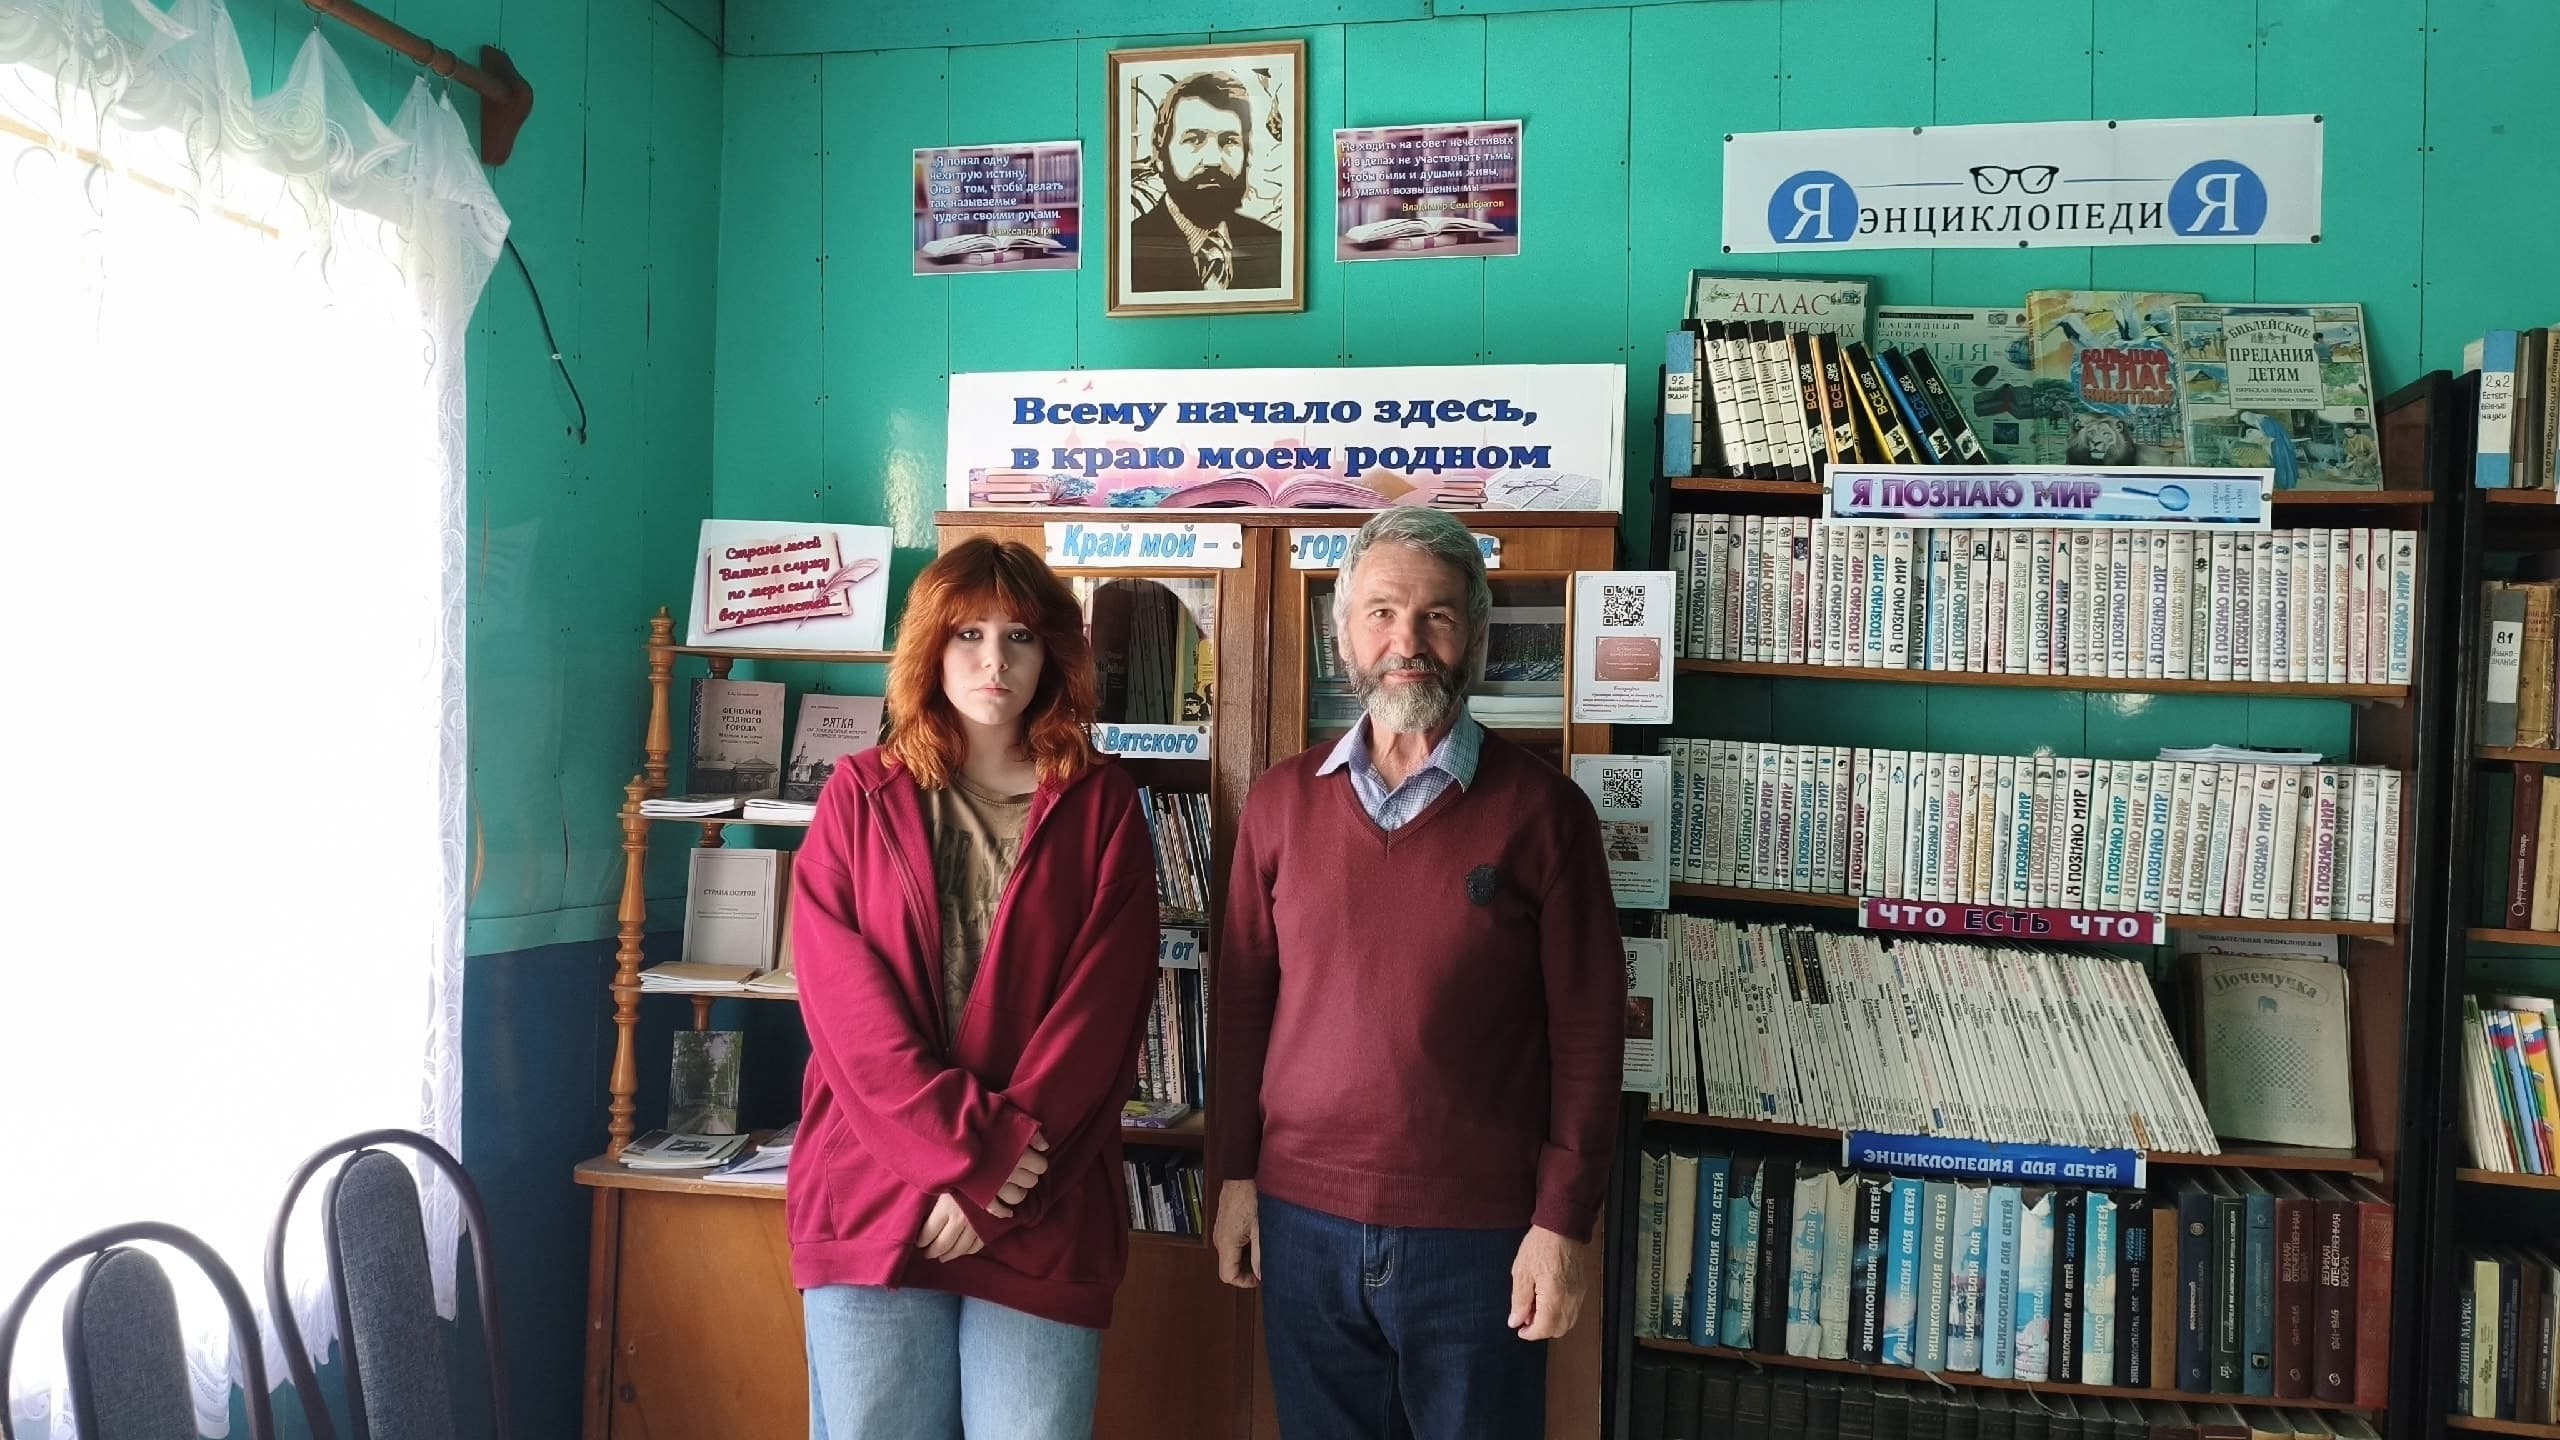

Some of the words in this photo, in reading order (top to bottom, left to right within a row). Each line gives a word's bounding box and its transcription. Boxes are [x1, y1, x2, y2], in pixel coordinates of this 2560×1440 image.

[1342, 142, 1354, 151] Не
[1358, 141, 1396, 151] ходить
[1416, 139, 1446, 148] совет
[1450, 137, 1514, 146] нечестивых
[947, 157, 979, 166] понял
[983, 156, 1009, 167] одну
[1342, 158, 1350, 166] И
[1364, 157, 1394, 168] делах
[1414, 155, 1480, 166] участвовать
[1484, 153, 1513, 161] тьмы,
[930, 184, 950, 194] Она
[964, 185, 988, 194] том,
[991, 182, 1023, 191] чтобы
[1026, 182, 1063, 192] делать
[931, 170, 982, 182] нехитрую
[1343, 171, 1375, 182] Чтобы
[1379, 171, 1406, 180] были
[1420, 170, 1462, 180] душами
[930, 200, 947, 208] так
[951, 198, 1016, 207] называемые
[1342, 188, 1351, 197] И
[1354, 188, 1389, 199] умами
[1393, 185, 1459, 195] возвышенны
[1464, 184, 1478, 192] мы
[933, 214, 969, 224] чудеса
[973, 212, 1015, 220] своими
[1019, 210, 1061, 222] руками.
[1402, 202, 1447, 212] Владимир
[1784, 183, 1835, 241] Я
[1859, 202, 2163, 238] ЭНЦИКЛОПЕДИ
[2187, 174, 2242, 234] Я
[1732, 291, 1832, 316] АТЛАС
[2228, 319, 2311, 338] БИБЛЕЙСКИЕ
[2230, 348, 2313, 364] ПРЕДАНИЯ
[2082, 363, 2172, 389] АТЛАС
[2248, 368, 2299, 382] ДЕТЯМ
[1804, 384, 1817, 410] ВСЕ
[1831, 383, 1844, 408] ВСЕ
[1870, 390, 1888, 415] ВСЕ
[1013, 396, 1163, 432] Всему
[1176, 401, 1361, 424] начало
[1374, 398, 1537, 427] здесь,
[1011, 447, 1038, 469] в
[1052, 447, 1184, 478] краю
[1197, 446, 1329, 469] моем
[1343, 444, 1551, 477] родном
[1851, 478, 1873, 507] Я
[1881, 478, 2024, 508] ПОЗНАЮ
[2032, 480, 2104, 509] МИР
[726, 542, 781, 562] Стране
[784, 536, 821, 553] моей
[1063, 524, 1132, 558] Край
[1140, 524, 1197, 558] мой
[719, 567, 768, 581] Вятке
[771, 564, 780, 574] я
[784, 558, 830, 576] служу
[1694, 549, 1707, 577] МИР
[1872, 554, 1885, 582] МИР
[728, 589, 745, 600] по
[749, 584, 784, 599] мере
[788, 581, 813, 592] сил
[817, 579, 826, 588] и
[2095, 563, 2107, 592] МИР
[2276, 568, 2289, 597] МИР
[1691, 580, 1706, 633] ПОЗНАЮ
[1870, 585, 1883, 638] ПОЗНАЮ
[2092, 595, 2106, 649] ПОЗНАЮ
[2274, 600, 2287, 655] ПОЗНАЮ
[1691, 634, 1704, 644] Я
[1868, 641, 1881, 651] Я
[2090, 652, 2103, 662] Я
[2273, 658, 2286, 669] Я
[722, 707, 762, 716] ФЕНОМЕН
[822, 717, 854, 729] ВЯТКА
[1106, 726, 1198, 753] Вятского
[1693, 773, 1706, 801] МИР
[1781, 783, 1794, 810] МИР
[2073, 789, 2088, 819] МИР
[2153, 793, 2168, 823] МИР
[2320, 799, 2335, 830] МИР
[1690, 803, 1704, 855] ПОЗНАЮ
[1777, 812, 1791, 866] ПОЗНАЮ
[1688, 858, 1701, 868] Я
[2069, 824, 2084, 882] ПОЗНАЮ
[2147, 828, 2164, 886] ПОЗНАЮ
[2315, 833, 2333, 892] ПОЗНАЮ
[1775, 868, 1789, 878] Я
[2066, 886, 2080, 896] Я
[2144, 889, 2159, 900] Я
[2315, 895, 2329, 907] Я
[1879, 904, 1946, 927] ЧТО
[1964, 909, 2050, 933] ЕСТЬ
[2070, 915, 2139, 937] ЧТО
[2214, 972, 2317, 998] Почемучка
[1863, 1149, 2013, 1173] ЭНЦИКЛОПЕДИЯ
[2020, 1161, 2056, 1176] ДЛЯ
[2064, 1162, 2118, 1179] ДЕТЕЙ
[1713, 1172, 1723, 1209] ДЕТЕЙ
[1870, 1187, 1880, 1223] ДЕТЕЙ
[1936, 1194, 1946, 1230] ДЕТЕЙ
[2004, 1199, 2013, 1235] ДЕТЕЙ
[1712, 1213, 1721, 1236] ДЛЯ
[1869, 1228, 1879, 1251] ДЛЯ
[1935, 1235, 1944, 1259] ДЛЯ
[1971, 1232, 1981, 1254] ДЛЯ
[2331, 1213, 2341, 1286] ОТЕЧЕСТВЕННАЯ
[2003, 1241, 2011, 1265] ДЛЯ
[2321, 1245, 2330, 1286] ВЕЛИКАЯ
[1705, 1241, 1719, 1336] ЭНЦИКЛОПЕДИЯ
[1863, 1256, 1877, 1351] ЭНЦИКЛОПЕДИЯ
[1928, 1263, 1942, 1360] ЭНЦИКЛОПЕДИЯ
[1996, 1270, 2009, 1366] ЭНЦИКЛОПЕДИЯ
[2461, 1298, 2472, 1339] МАРКС
